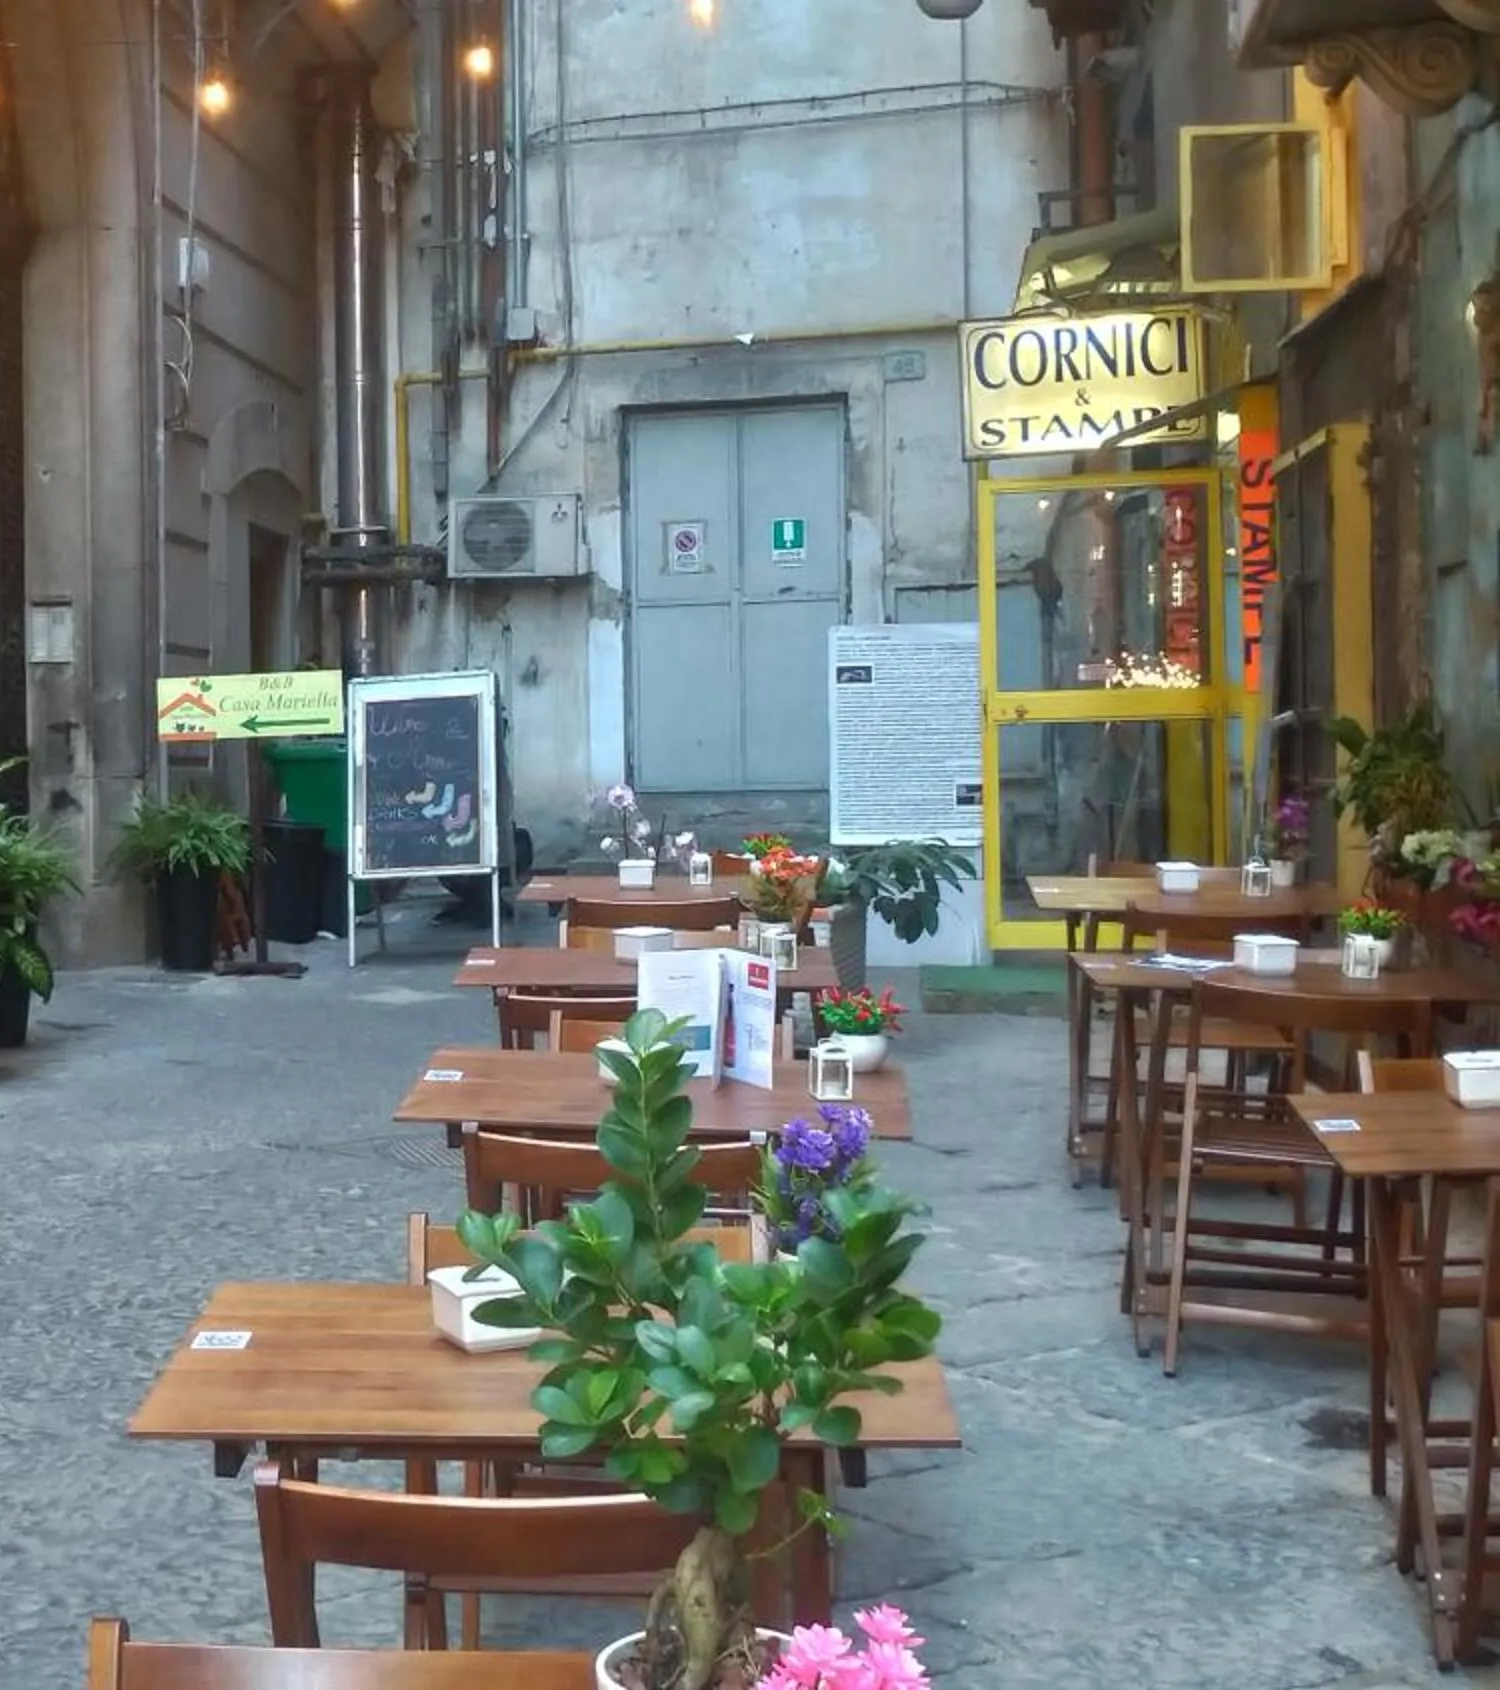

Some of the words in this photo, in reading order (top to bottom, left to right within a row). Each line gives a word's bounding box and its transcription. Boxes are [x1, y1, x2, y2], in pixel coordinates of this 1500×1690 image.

[973, 316, 1189, 390] CORNICI
[1074, 388, 1091, 407] &
[981, 405, 1192, 447] STAMPE
[258, 675, 295, 692] B&B
[219, 695, 261, 714] Casa
[265, 691, 338, 710] Mariella
